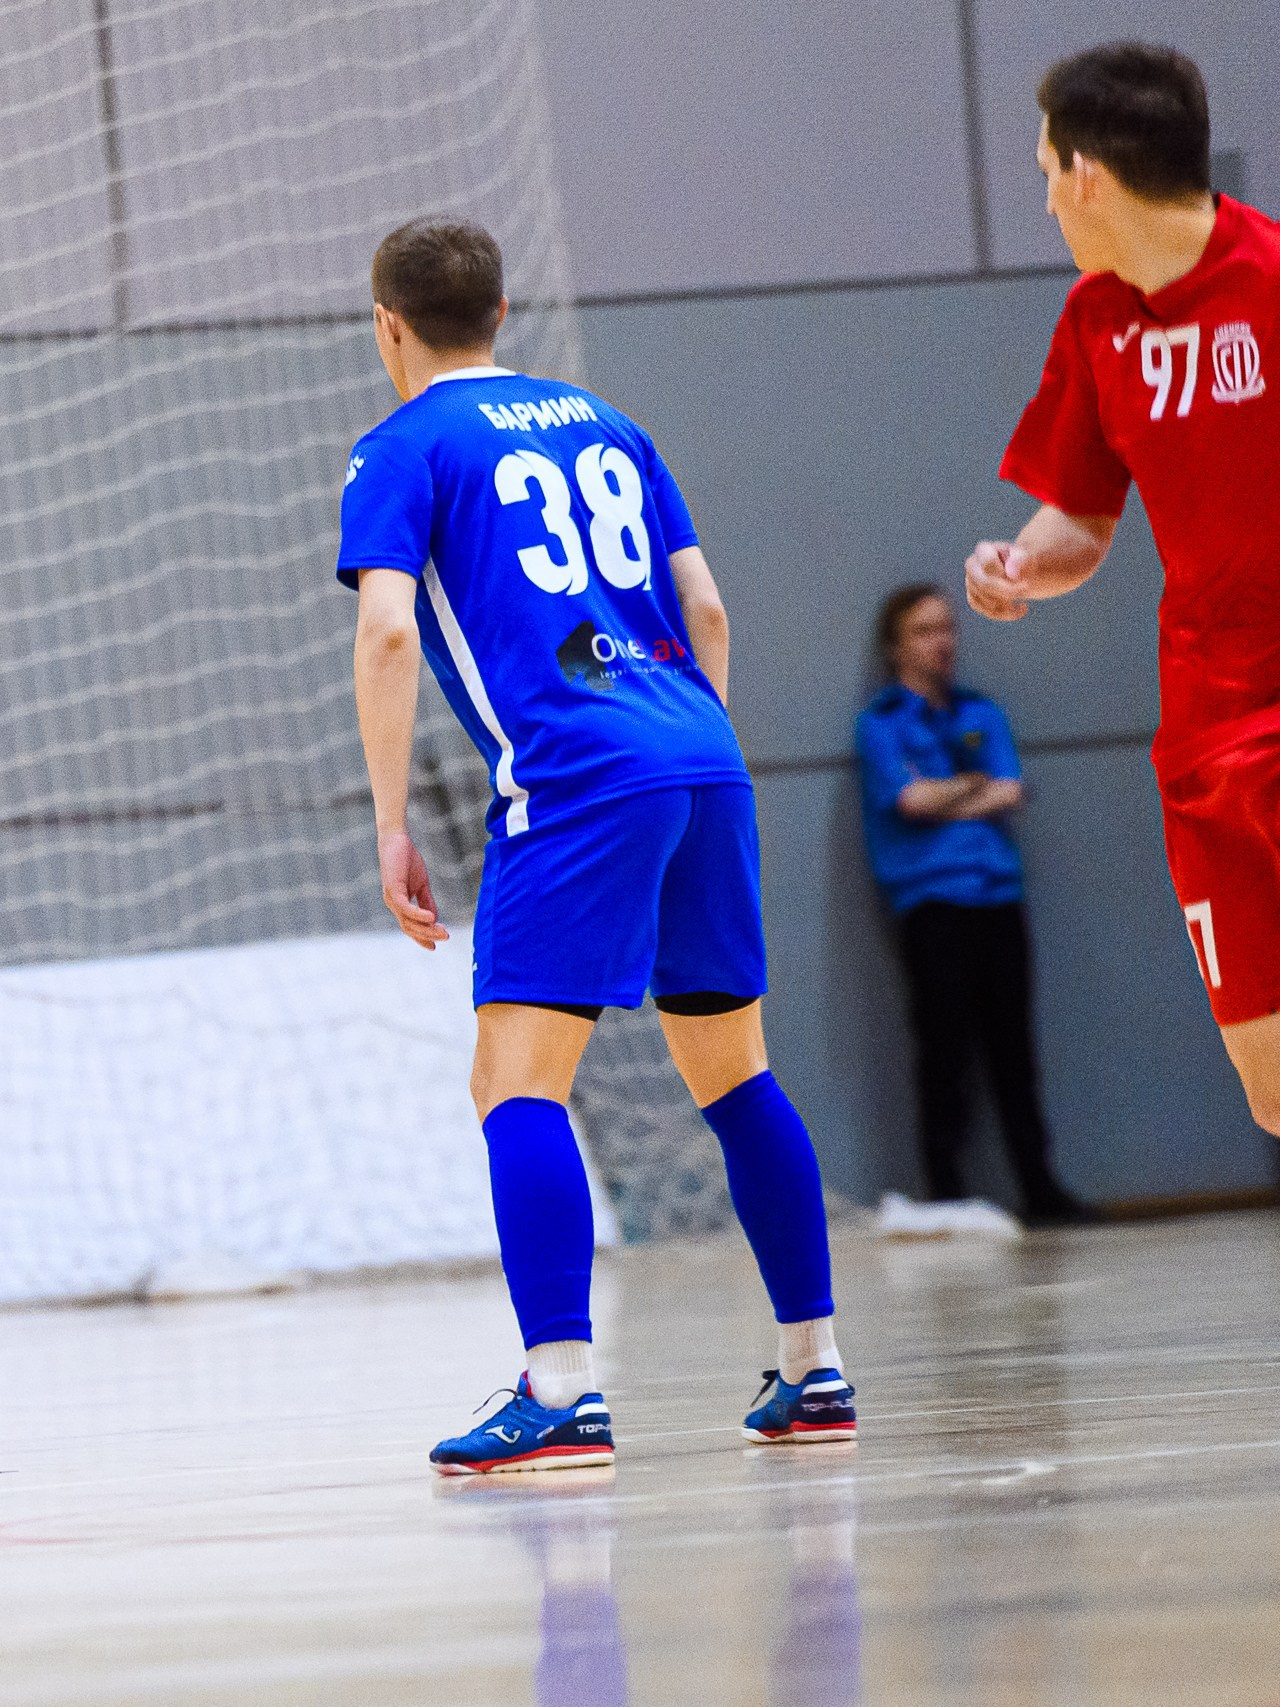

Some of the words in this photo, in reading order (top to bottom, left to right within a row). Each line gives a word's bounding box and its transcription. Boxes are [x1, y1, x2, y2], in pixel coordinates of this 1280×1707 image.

[478, 396, 597, 431] БАРМИН
[1141, 322, 1200, 421] 97
[494, 443, 652, 596] 38
[1184, 899, 1221, 988] 7
